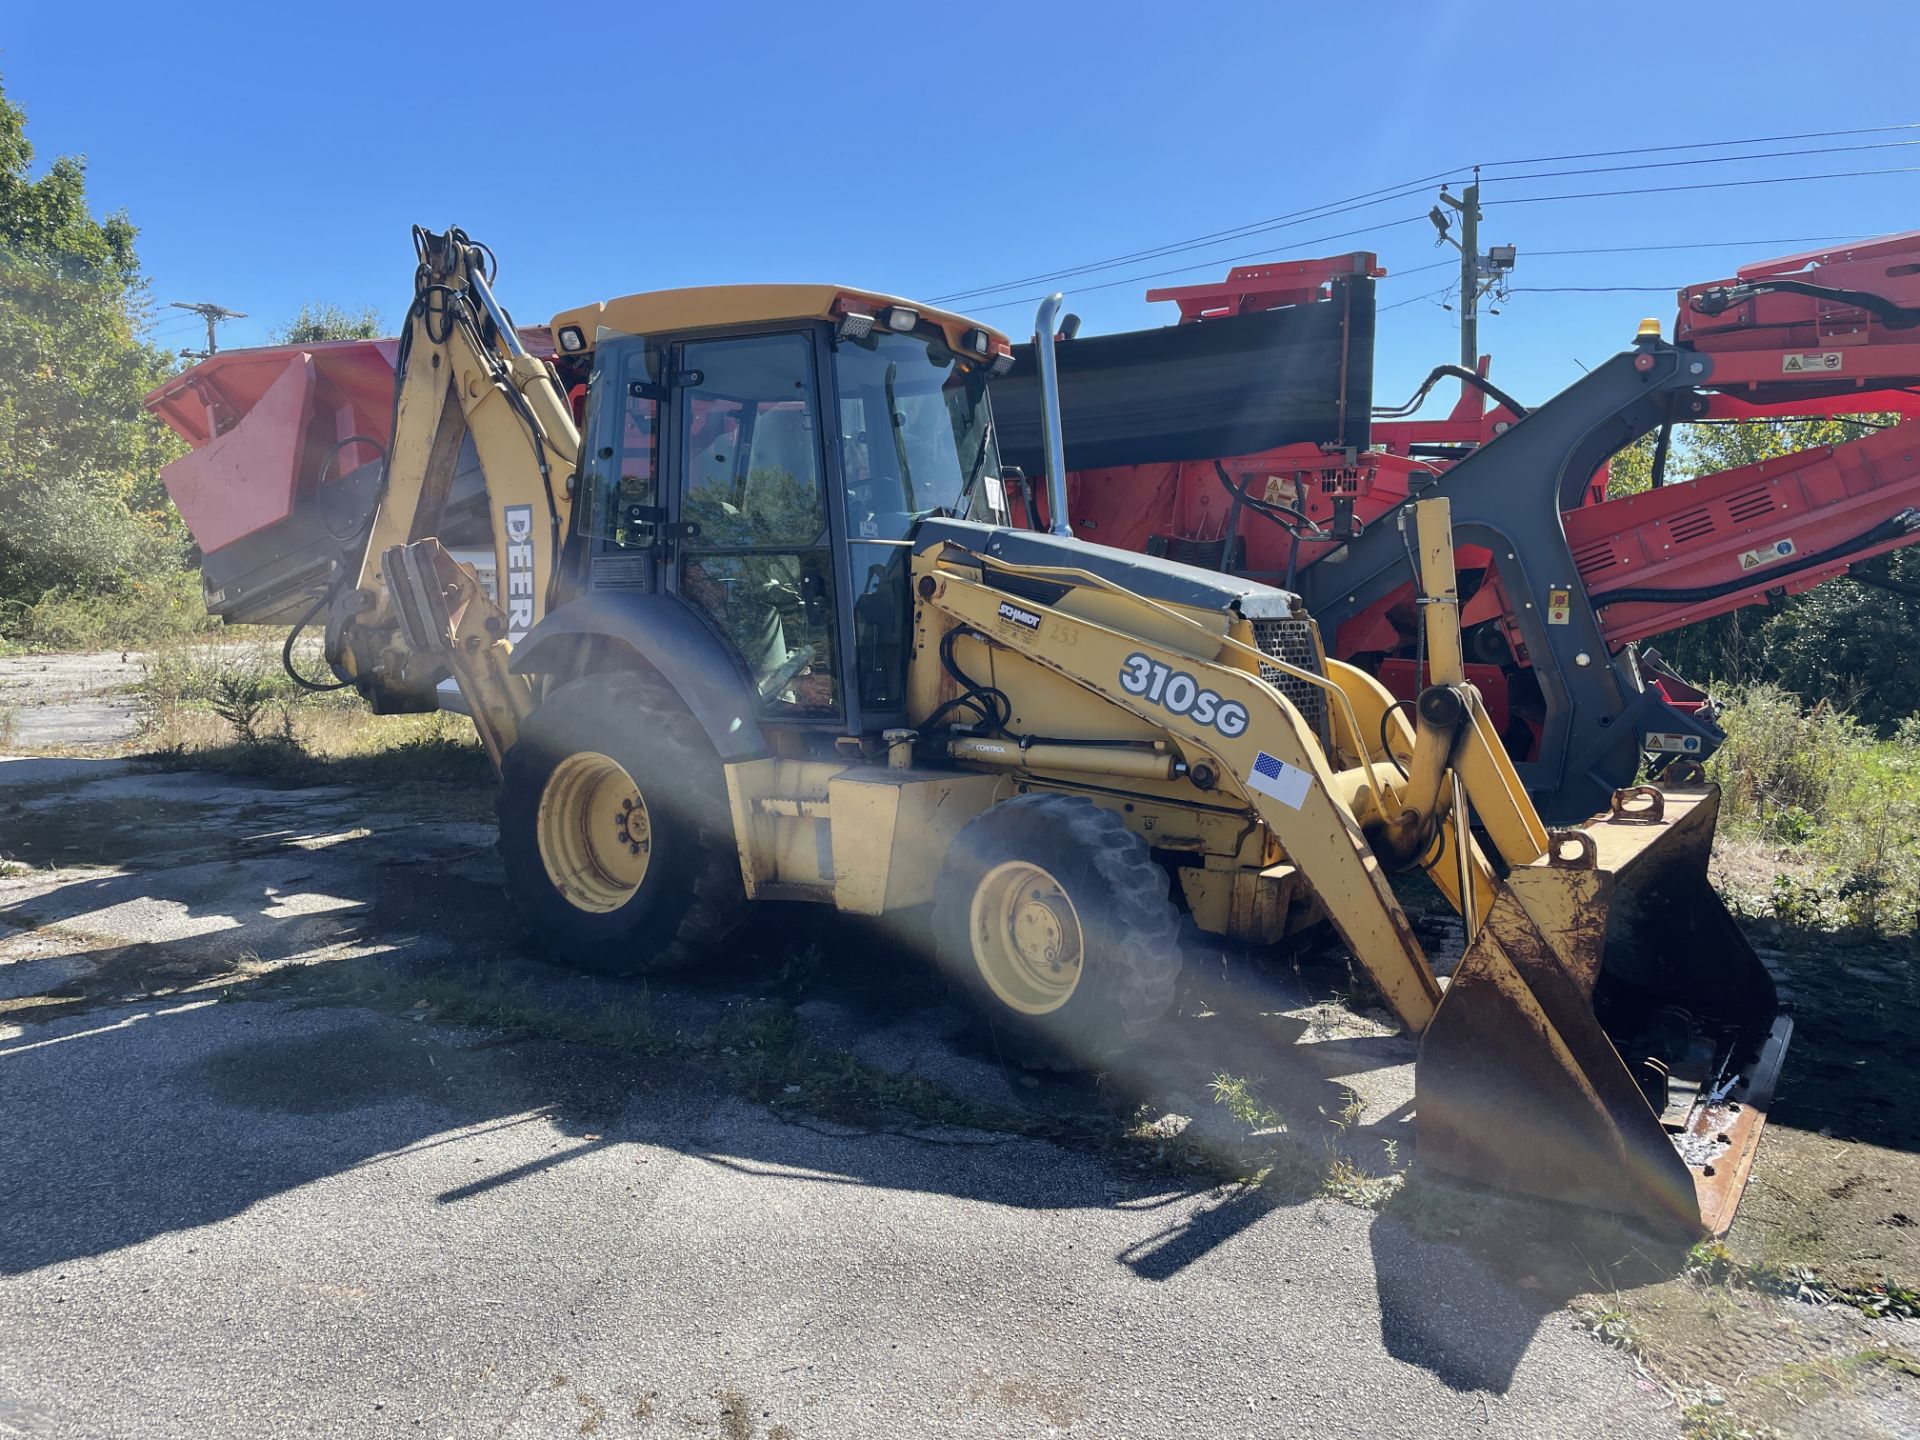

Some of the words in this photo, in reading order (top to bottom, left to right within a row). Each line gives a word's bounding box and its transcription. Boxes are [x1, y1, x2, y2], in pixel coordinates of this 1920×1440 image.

[999, 603, 1040, 627] SCHMIDT
[1049, 621, 1080, 647] 253
[1120, 654, 1249, 736] 310SG
